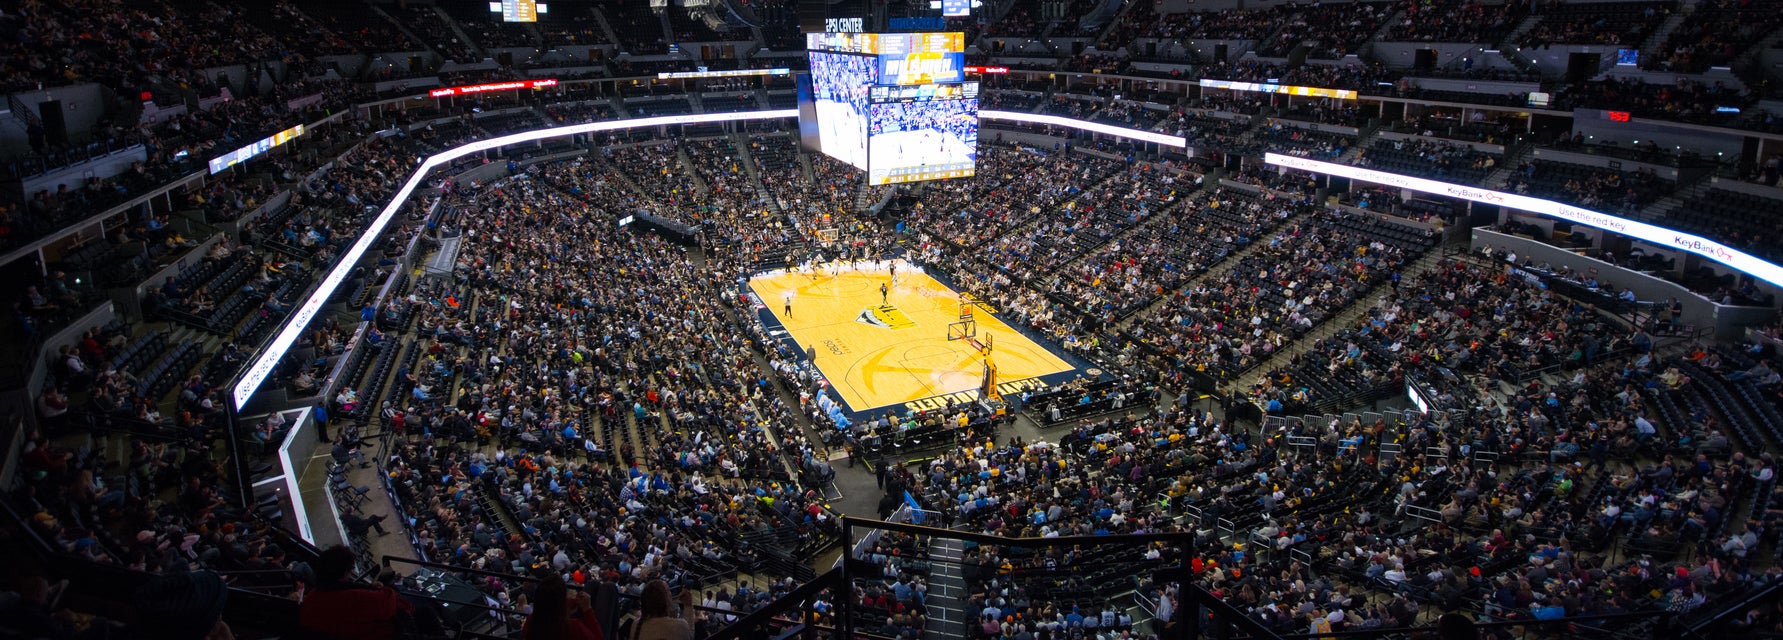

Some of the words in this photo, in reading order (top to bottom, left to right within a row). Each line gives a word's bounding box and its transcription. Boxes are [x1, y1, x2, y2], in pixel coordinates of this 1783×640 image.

[1447, 186, 1484, 199] KeyBank
[1559, 206, 1575, 218] Use
[1576, 212, 1591, 221] the
[1592, 216, 1608, 226] red
[1674, 236, 1715, 255] KeyBank
